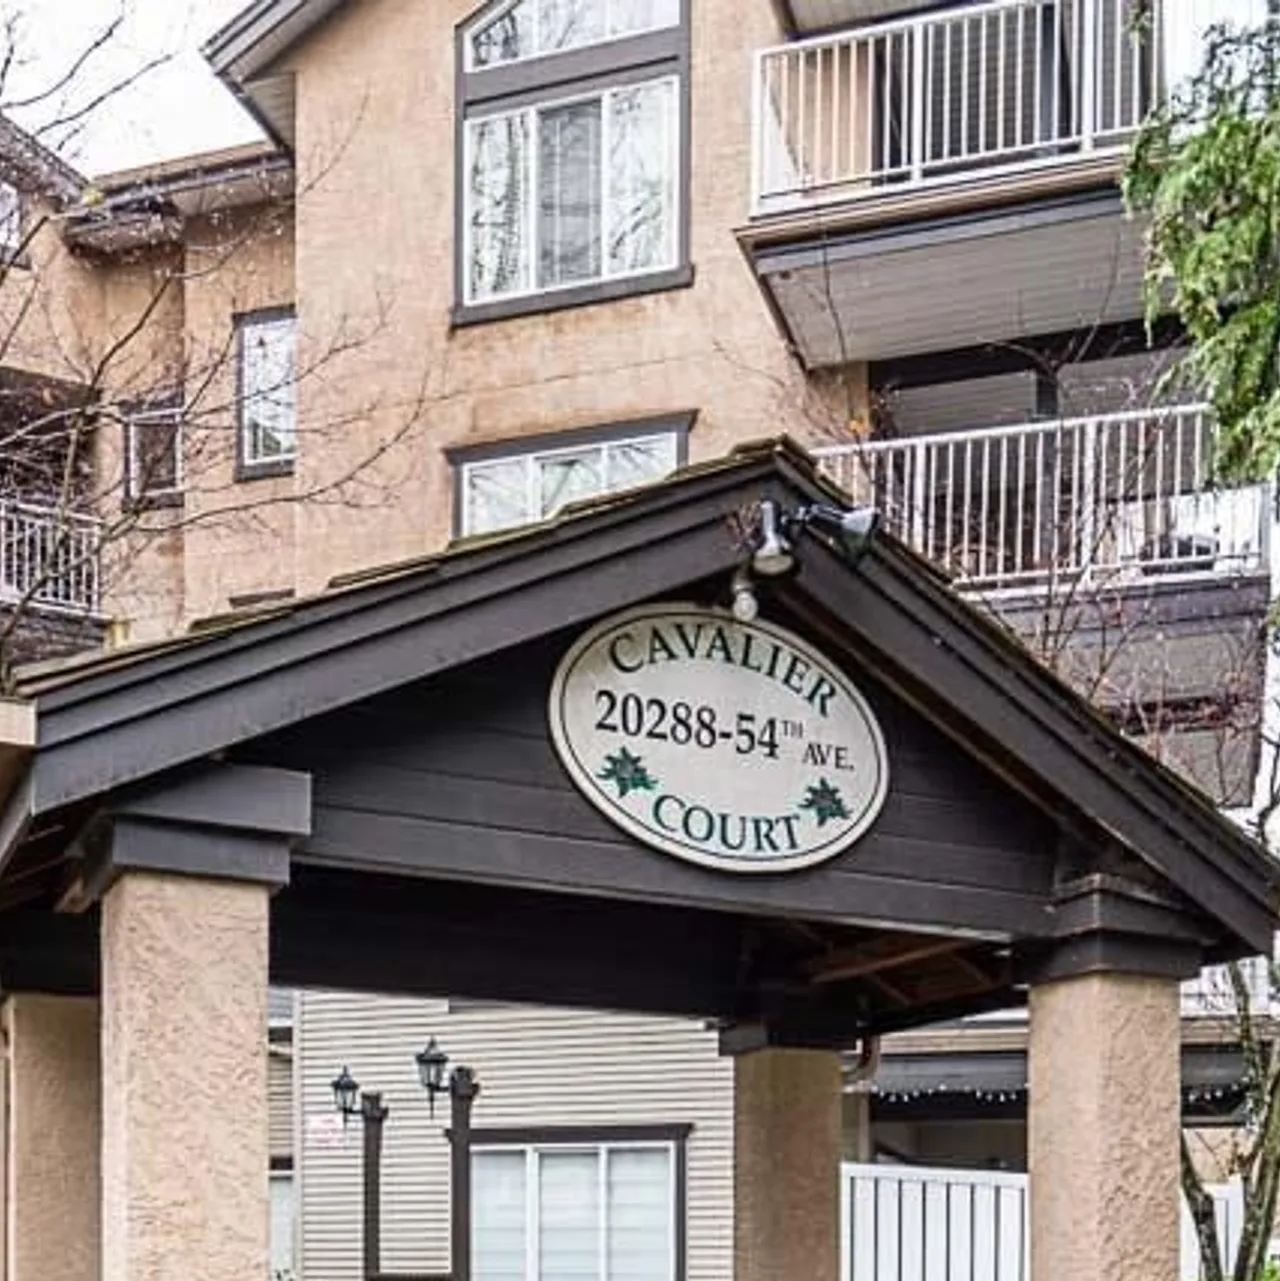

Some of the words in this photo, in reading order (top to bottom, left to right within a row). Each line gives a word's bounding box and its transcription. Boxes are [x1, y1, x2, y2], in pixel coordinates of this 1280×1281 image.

[610, 624, 836, 716] CAVALIER
[803, 744, 854, 771] AVE.
[653, 796, 800, 851] COURT
